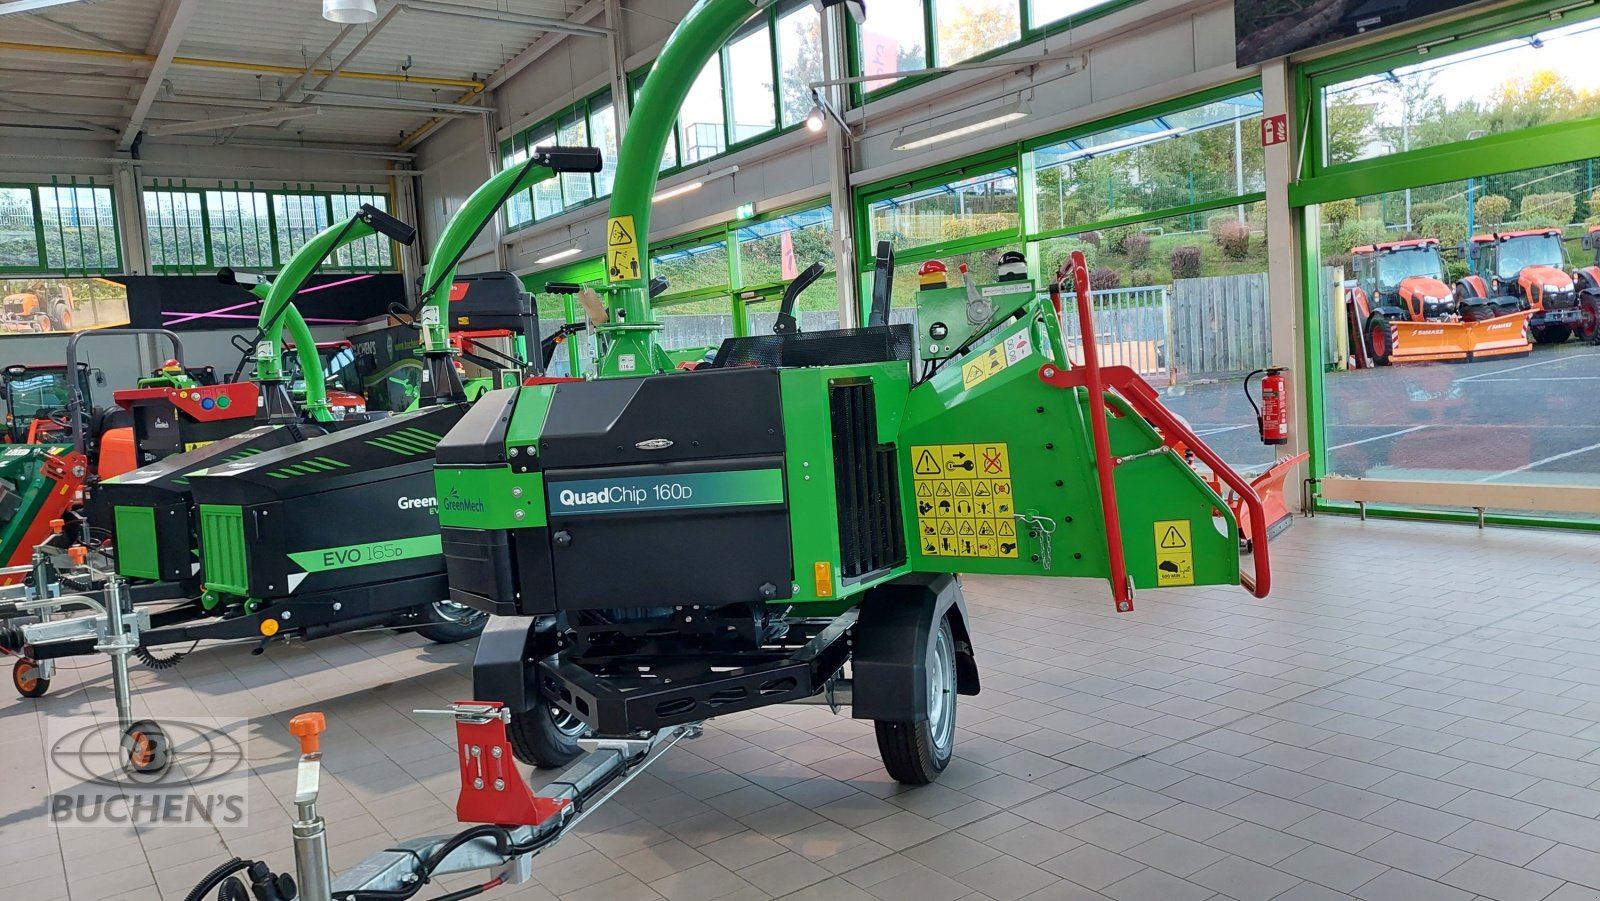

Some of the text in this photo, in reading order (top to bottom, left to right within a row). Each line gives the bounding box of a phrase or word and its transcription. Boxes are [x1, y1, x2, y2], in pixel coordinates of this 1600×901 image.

[397, 496, 438, 510] Green
[559, 483, 692, 505] QuadChip 160D
[443, 497, 484, 513] GreenMech
[323, 543, 403, 567] EVO 165D
